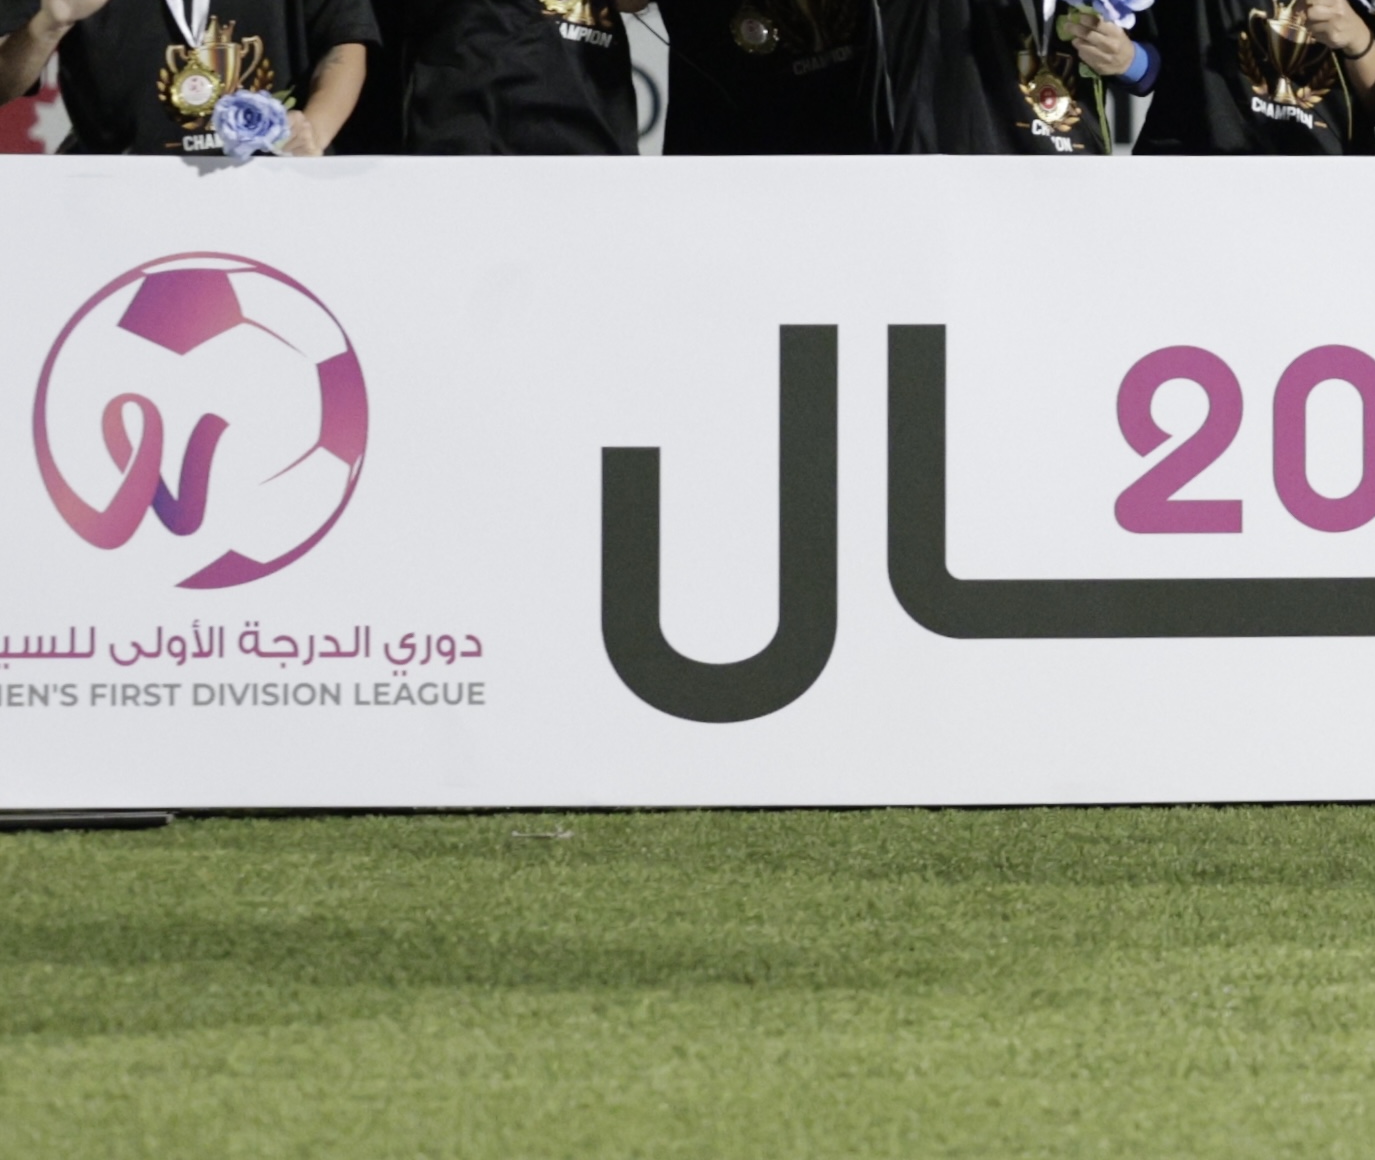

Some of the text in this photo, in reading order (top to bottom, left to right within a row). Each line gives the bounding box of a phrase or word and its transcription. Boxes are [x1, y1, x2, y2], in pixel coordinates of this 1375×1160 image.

[0, 618, 484, 677] دوري الدرجة الأولى للسي
[0, 681, 487, 709] EN'S FIRST DIVISION LEAGUE
